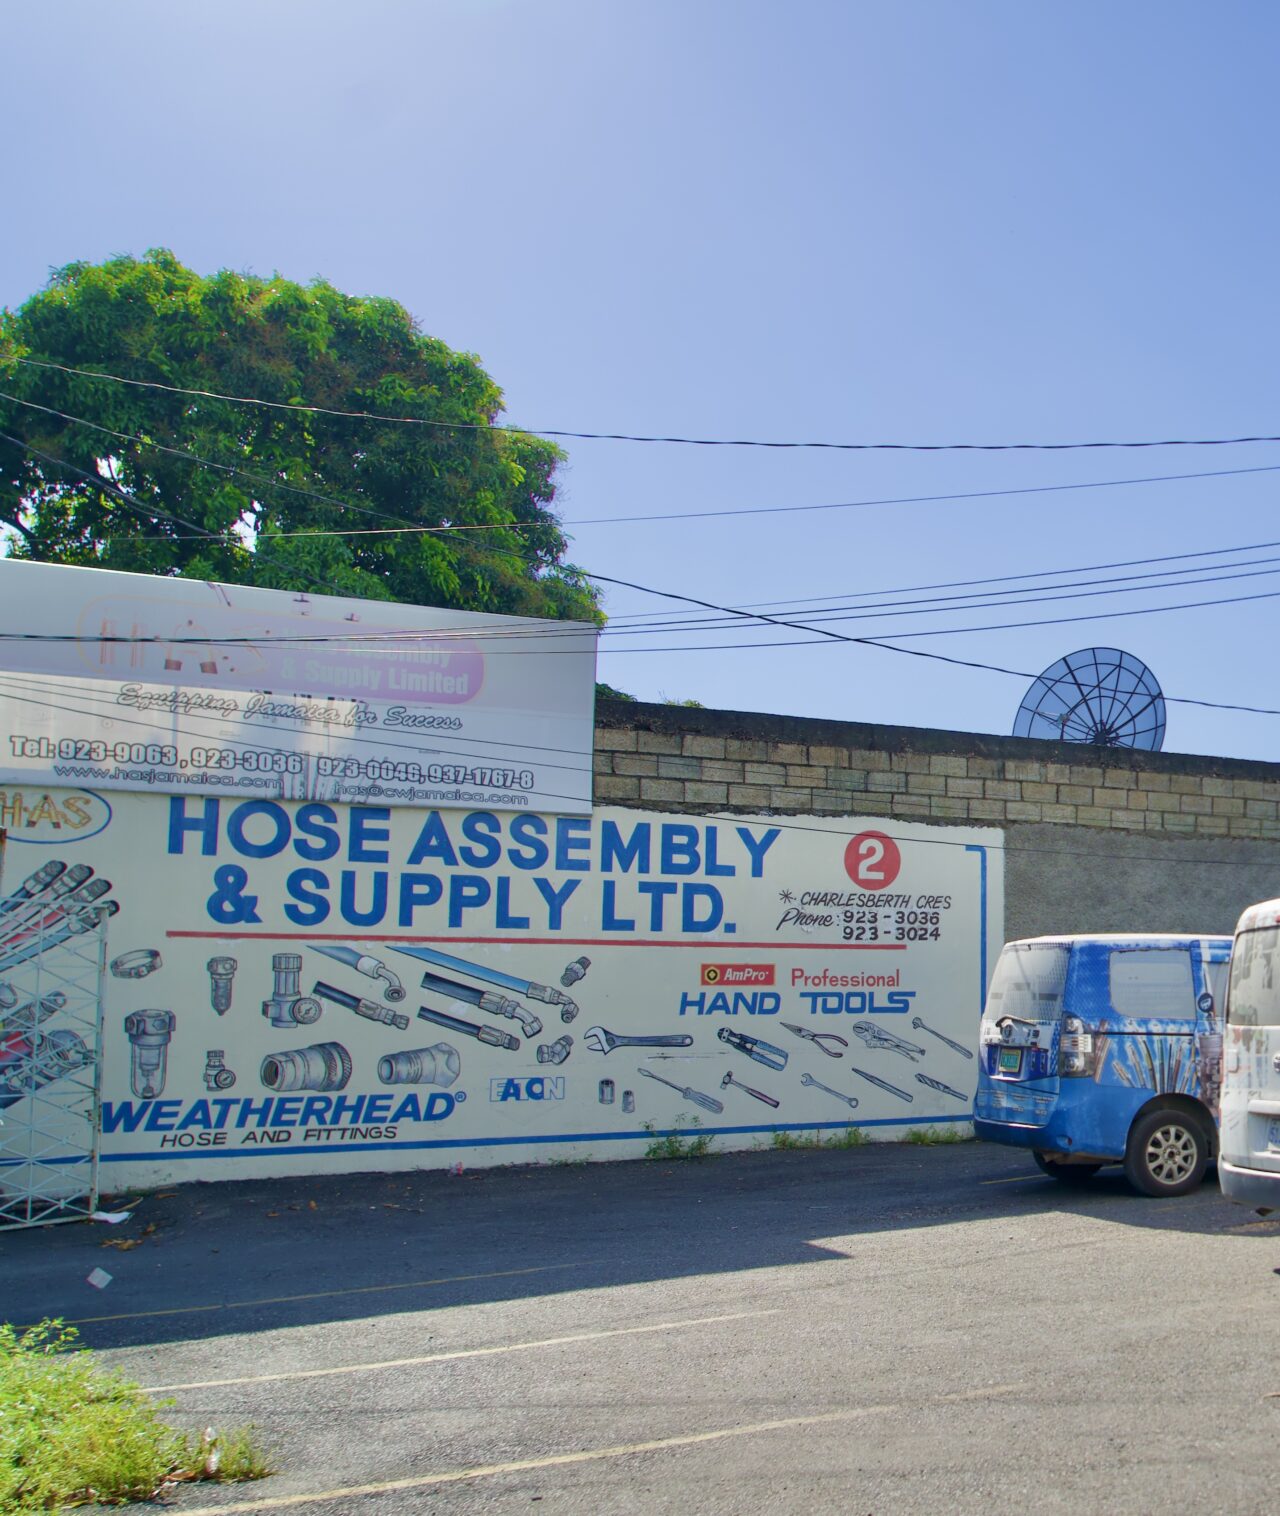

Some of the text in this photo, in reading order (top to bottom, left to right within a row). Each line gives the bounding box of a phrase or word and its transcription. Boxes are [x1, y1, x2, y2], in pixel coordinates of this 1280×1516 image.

[305, 659, 382, 690] Supply
[388, 667, 469, 695] Limited
[117, 683, 463, 730] Equipping Jamaica for Success
[9, 735, 56, 759] Tel:
[427, 763, 534, 790] 937-1767-8
[53, 764, 283, 789] www.hasjamaica.com
[334, 782, 529, 805] has@cwjamaica.com
[167, 795, 782, 878] HOSE ASSEMBLY
[858, 838, 885, 880] 2
[206, 864, 737, 934] & SUPPLY LTD.
[800, 891, 952, 910] CHARLESBERTH CRES
[723, 967, 900, 988] AmPro Professional
[679, 990, 917, 1016] HAND TOOLS
[489, 1076, 566, 1103] EATON
[160, 1126, 397, 1148] HOSE AND FITTINGS
